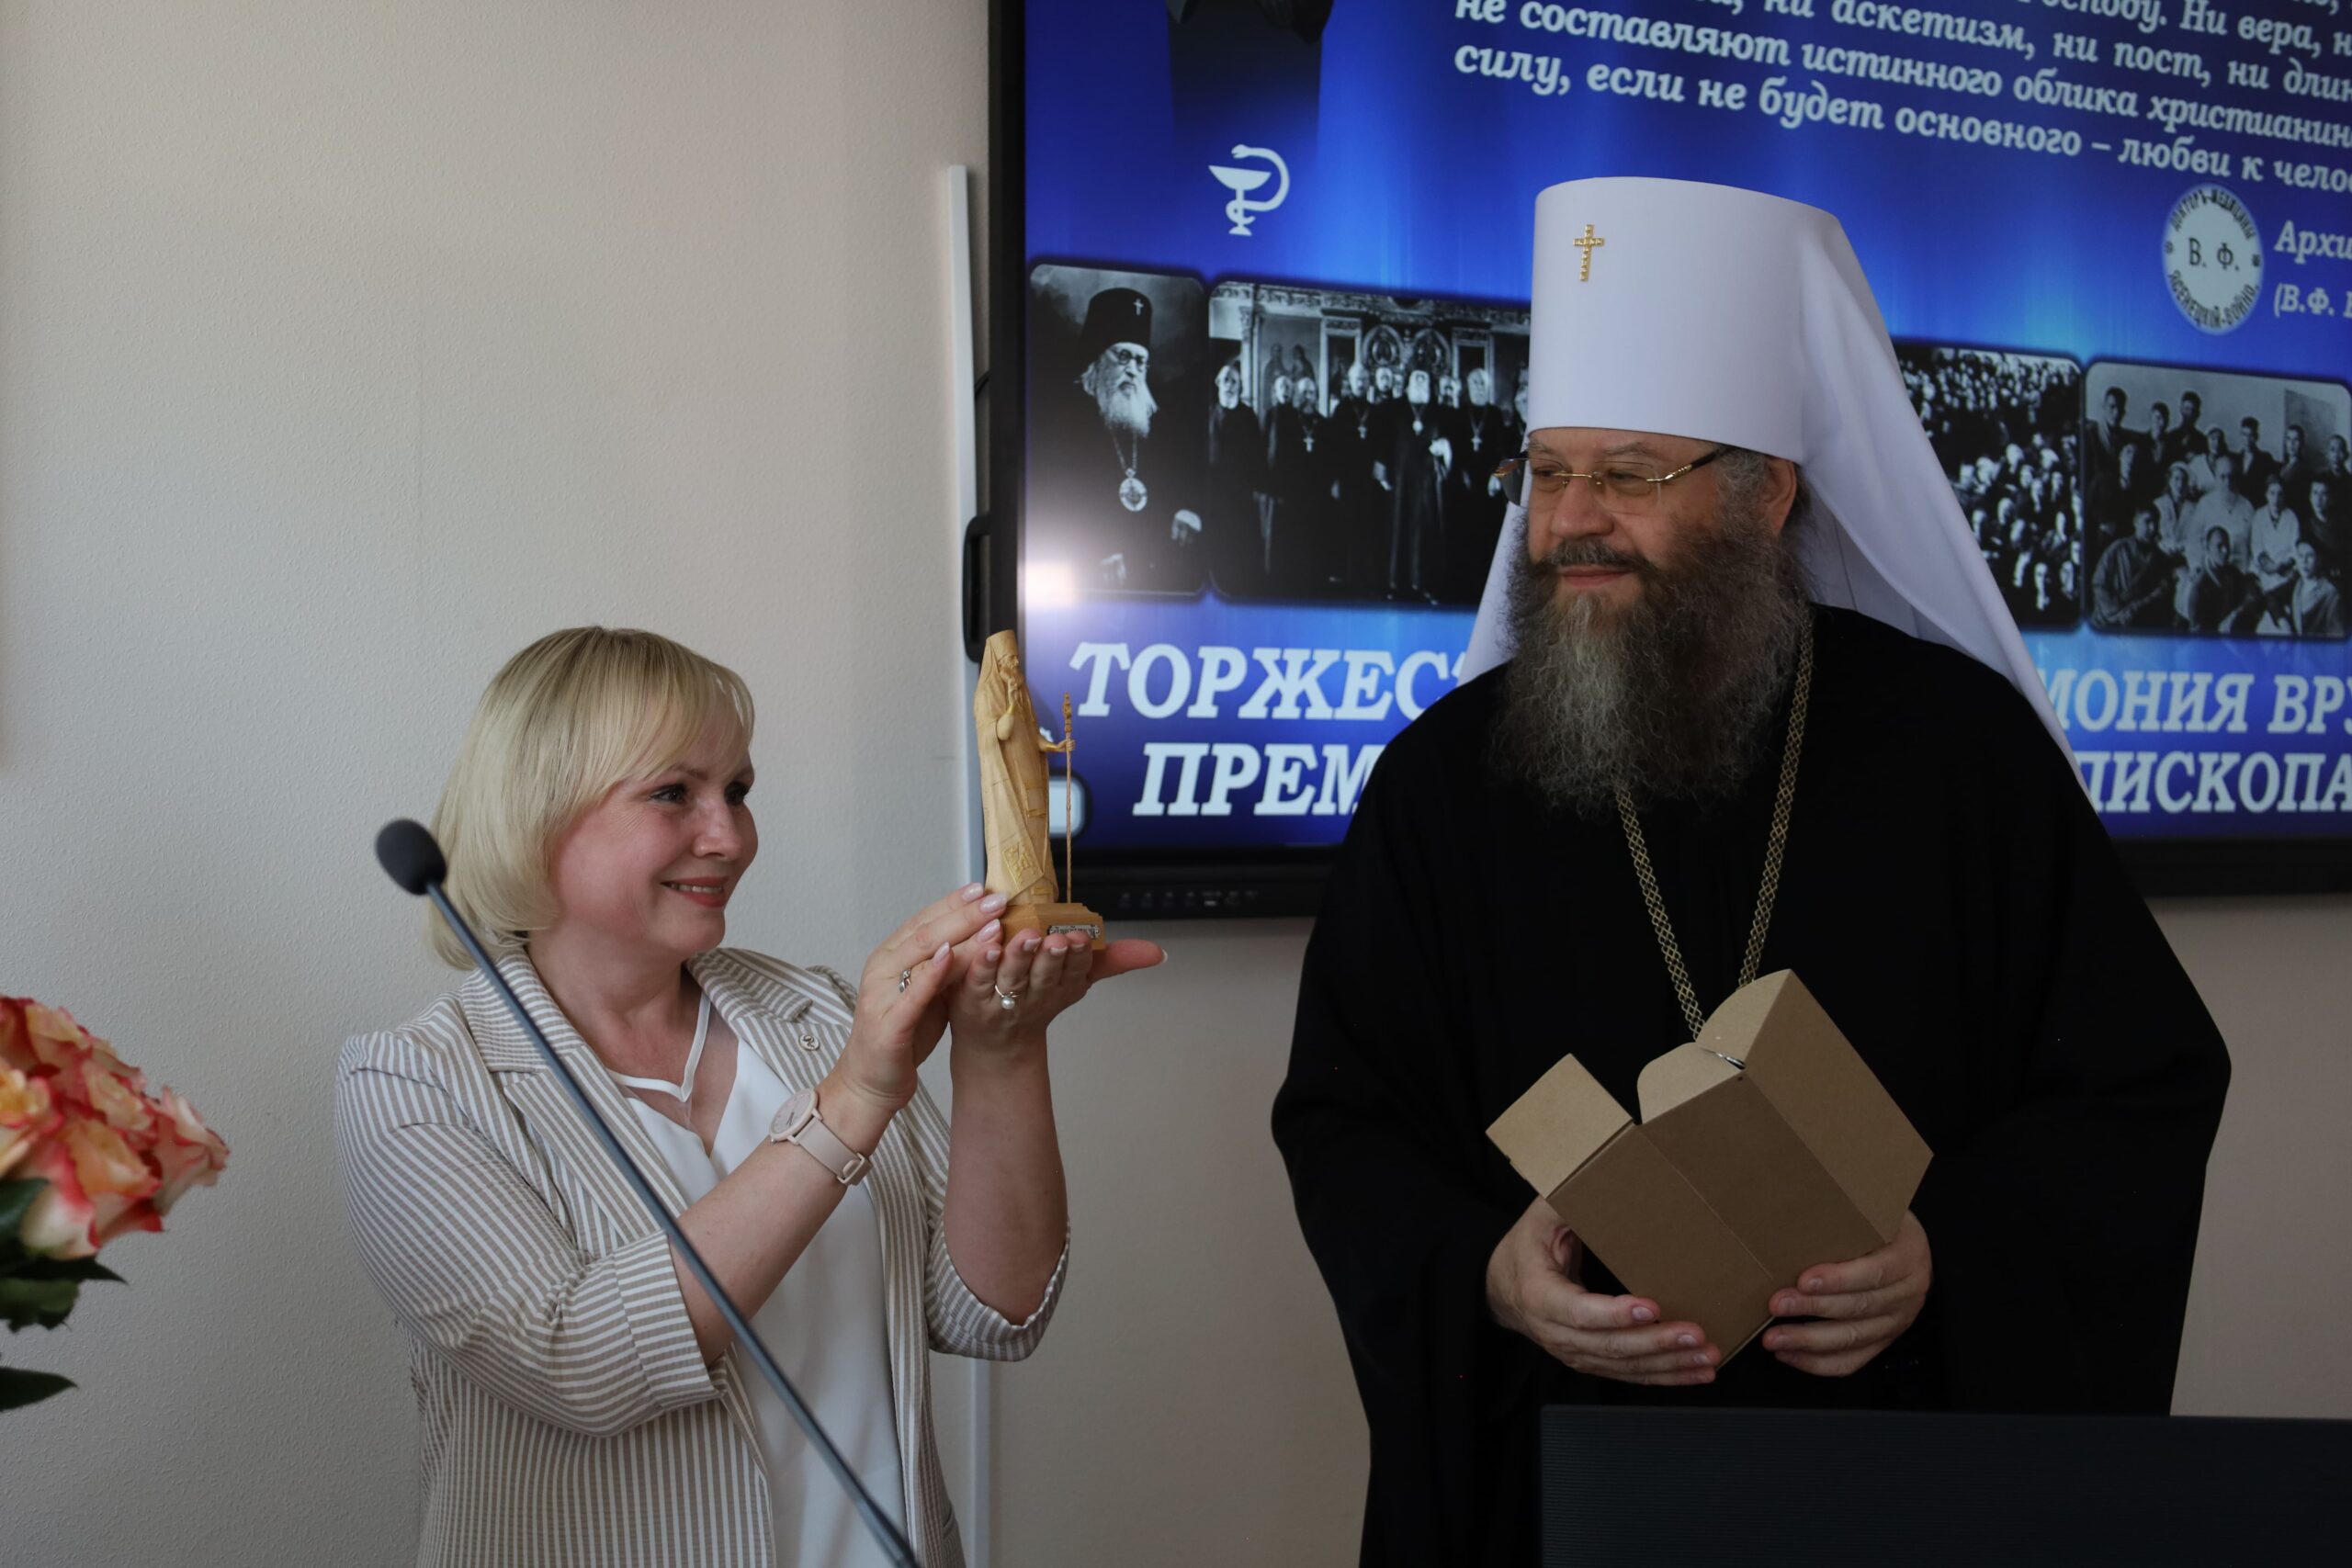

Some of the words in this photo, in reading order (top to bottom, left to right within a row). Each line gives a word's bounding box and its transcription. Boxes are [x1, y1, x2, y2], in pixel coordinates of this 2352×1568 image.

[1454, 0, 1508, 24] не
[1519, 0, 1791, 67] составляют
[1801, 43, 2003, 97] истинного
[2012, 67, 2140, 118] облика
[1831, 0, 2035, 61] аскетизм,
[2052, 32, 2098, 63] ни
[2113, 41, 2211, 88] пост,
[2227, 60, 2270, 90] ни
[2178, 0, 2228, 36] Ни
[2237, 15, 2322, 59] вера,
[1453, 44, 1571, 96] силу,
[1586, 63, 1686, 103] если
[1698, 79, 1747, 111] не
[1758, 76, 1885, 130] будет
[1894, 107, 2083, 156] основного
[2117, 134, 2232, 177] любви
[2241, 156, 2264, 182] к
[2273, 160, 2352, 194] чело
[2188, 236, 2207, 268] В.
[2216, 243, 2240, 272] Ф.
[2274, 220, 2352, 265] Архи
[2274, 283, 2335, 318] (В.Ф.
[1069, 641, 1467, 721] ТОРЖЕС
[2267, 674, 2352, 734] ВР
[1132, 742, 1387, 817] ПРЕМ
[2073, 750, 2352, 814] ПИСКОПА
